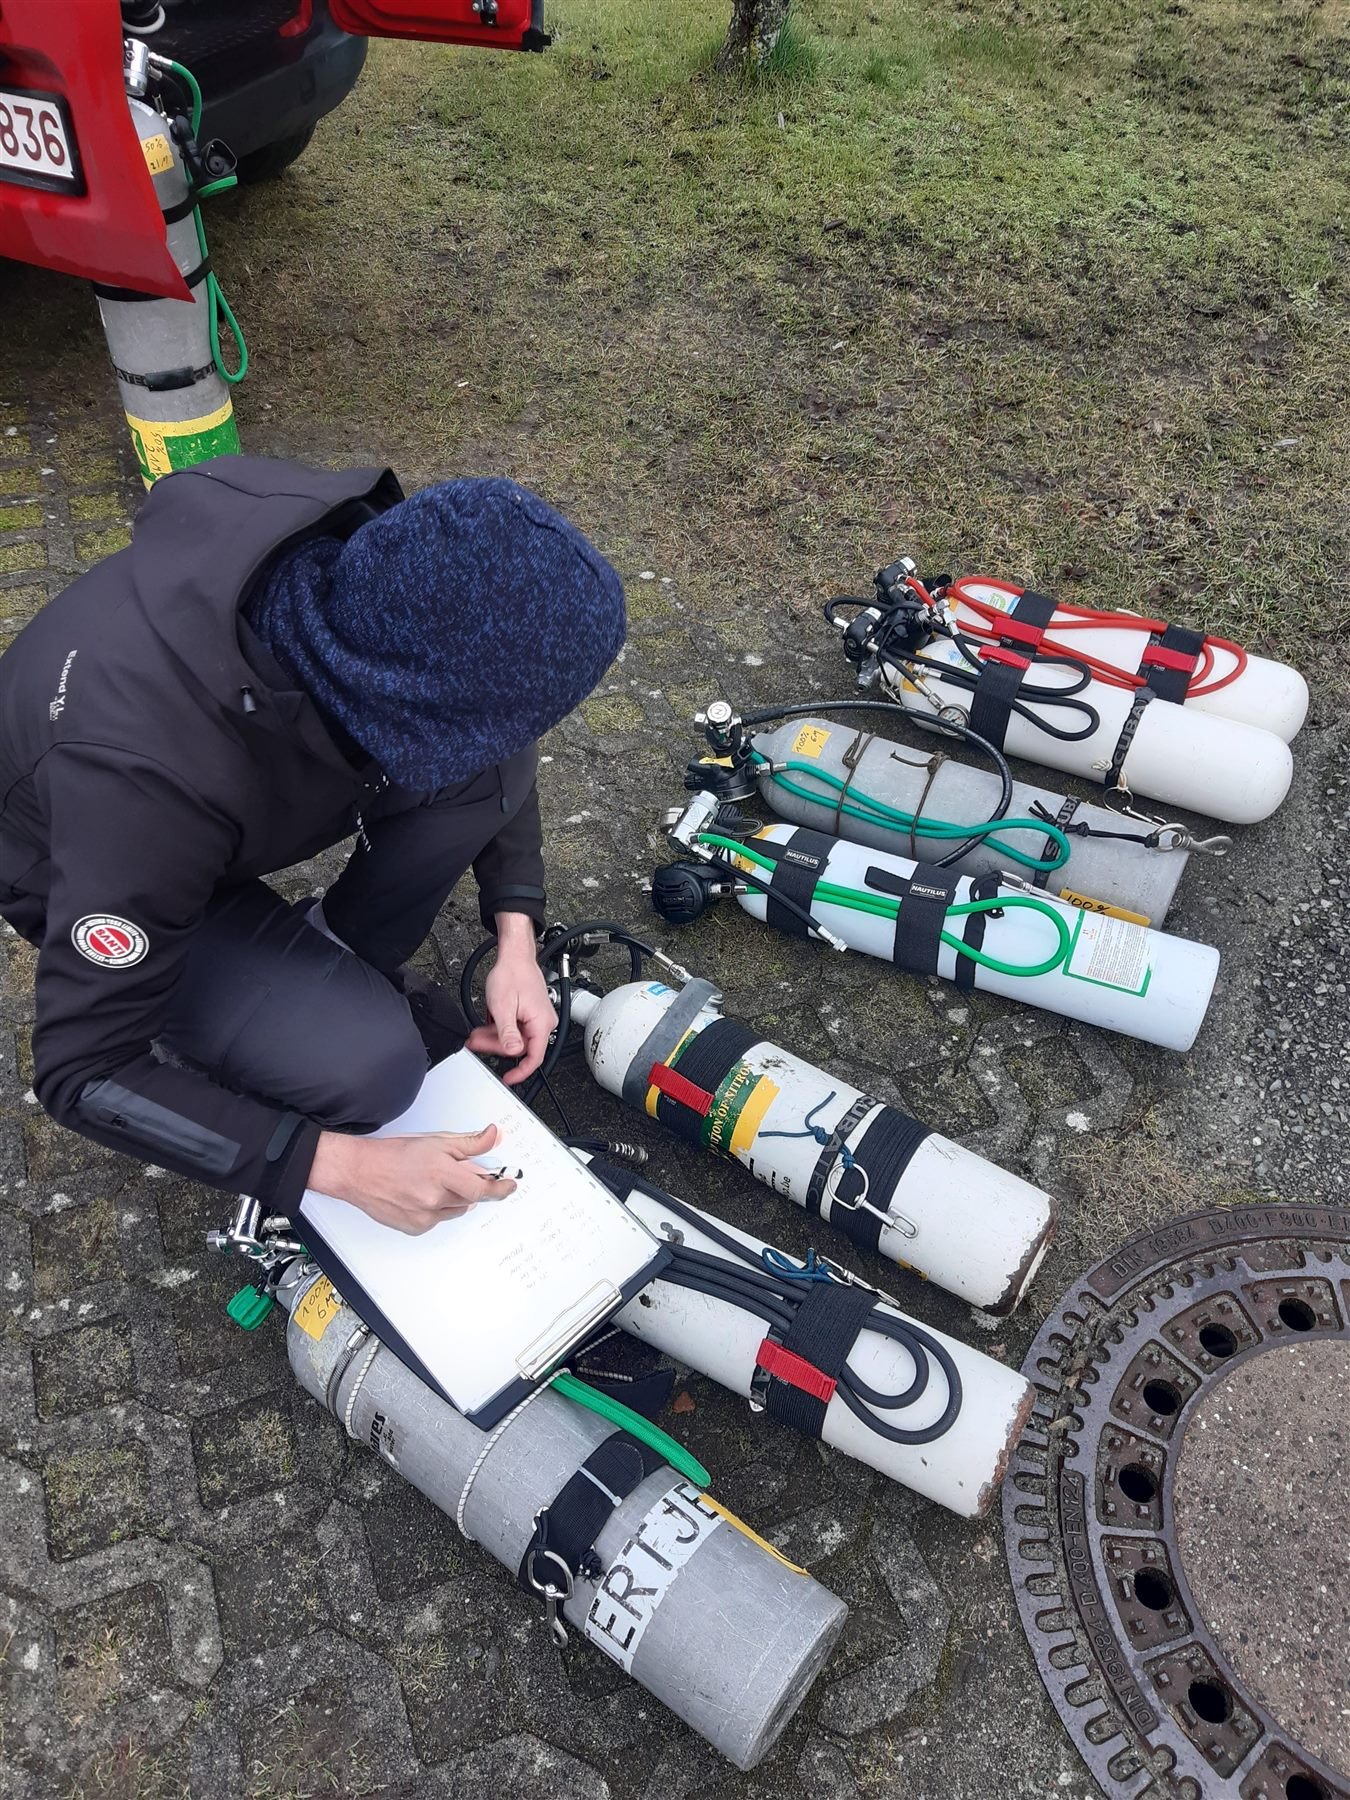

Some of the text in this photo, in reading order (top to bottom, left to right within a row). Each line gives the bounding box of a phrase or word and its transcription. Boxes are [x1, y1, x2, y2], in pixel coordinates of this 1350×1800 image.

[0, 102, 65, 166] 836
[145, 138, 162, 152] 50%
[58, 649, 77, 693] Extend
[786, 851, 819, 865] NAUTILUS
[911, 885, 946, 897] NAUTILUS
[718, 1101, 730, 1117] OF
[1112, 1249, 1147, 1278] DIN
[585, 1482, 719, 1666] ERTJE
[1120, 1685, 1153, 1726] DIN
